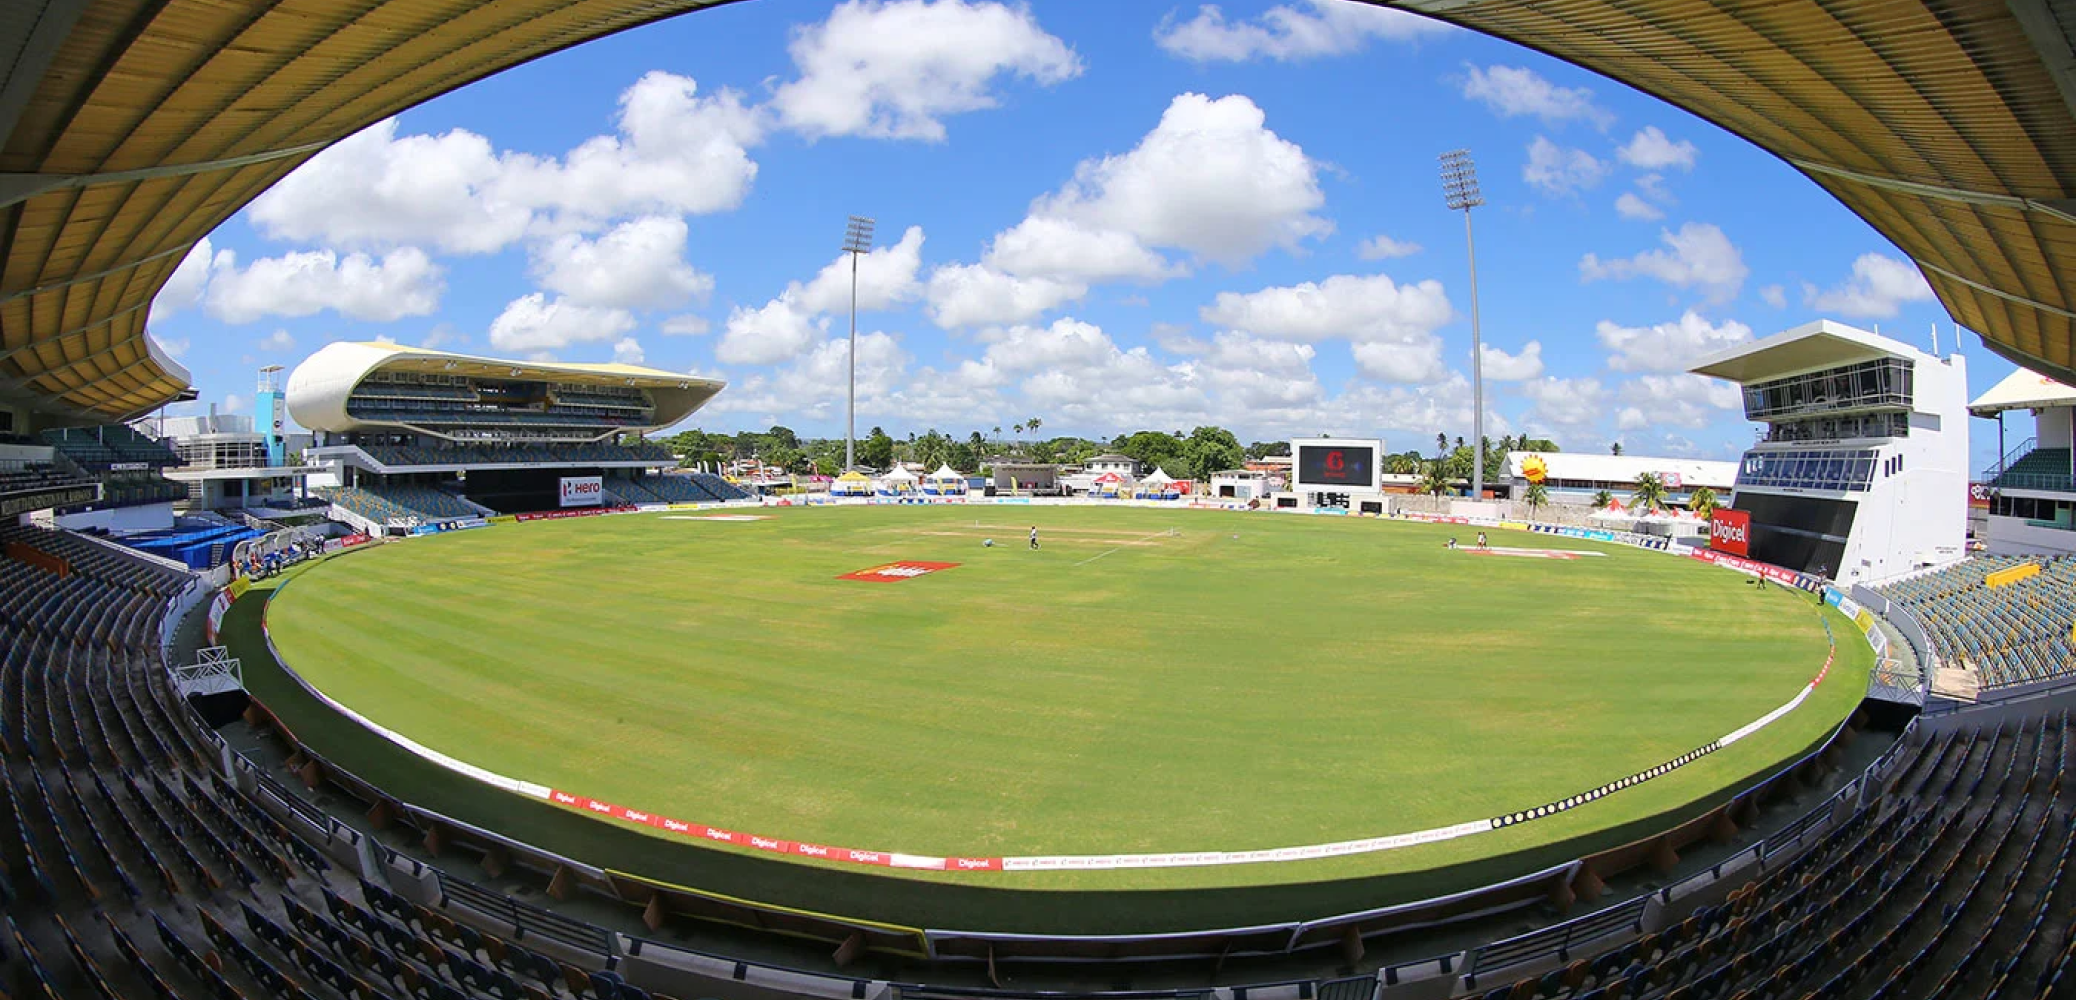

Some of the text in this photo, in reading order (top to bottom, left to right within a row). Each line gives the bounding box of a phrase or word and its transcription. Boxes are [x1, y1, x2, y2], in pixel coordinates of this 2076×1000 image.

[1713, 519, 1746, 544] Digicel
[752, 837, 777, 849] Digicel
[800, 844, 827, 855] Digicel
[850, 851, 878, 862] Digicel
[958, 859, 989, 868] Digicel
